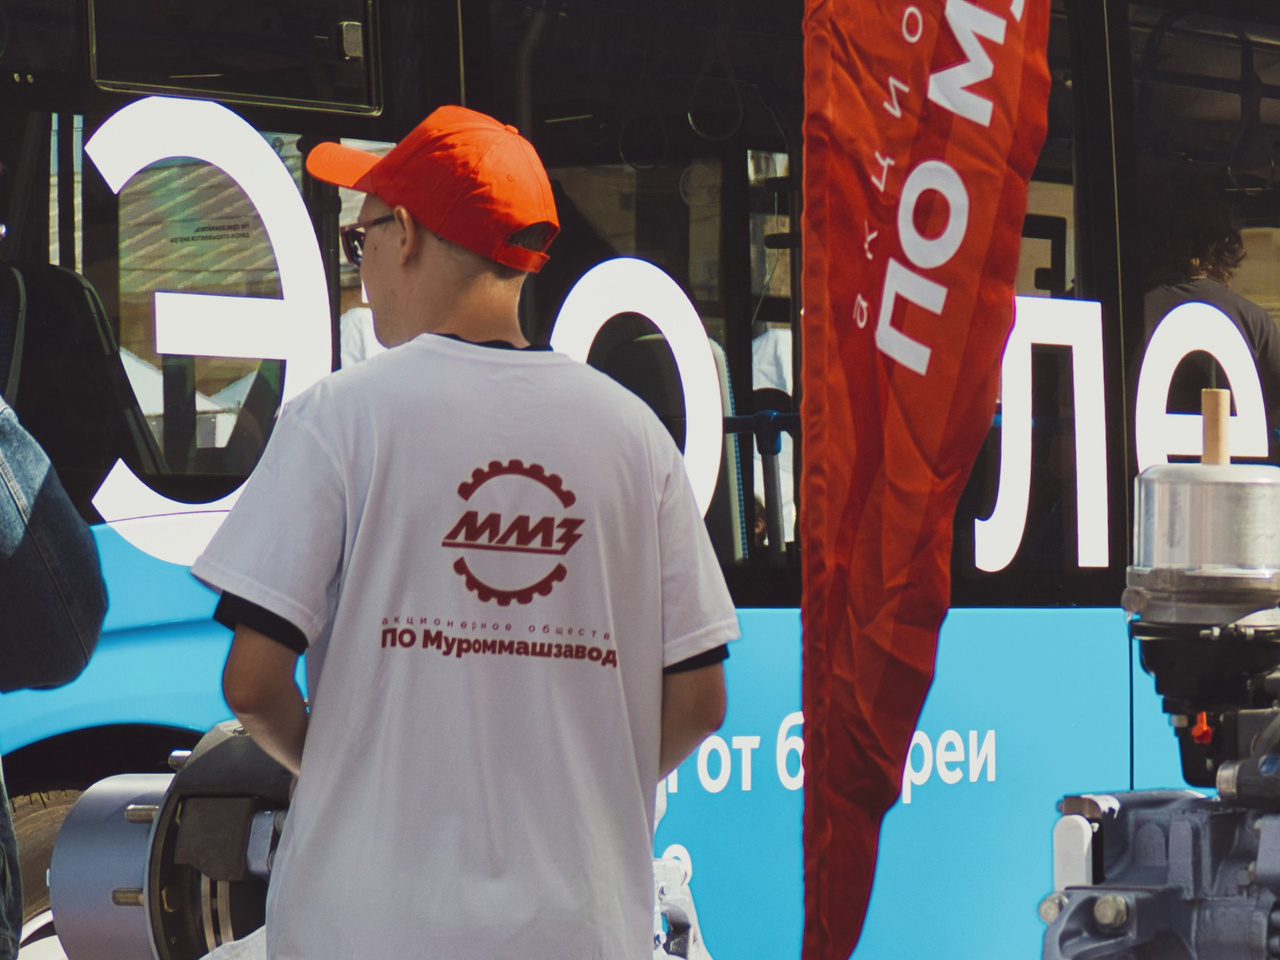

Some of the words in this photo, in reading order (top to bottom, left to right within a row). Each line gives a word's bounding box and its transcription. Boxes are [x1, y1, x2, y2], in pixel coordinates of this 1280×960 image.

[875, 159, 970, 376] ПО
[85, 96, 723, 566] Эо
[441, 510, 586, 556] ММЗ
[381, 628, 417, 649] ПО
[422, 629, 618, 668] Муроммашзавод
[382, 615, 512, 632] акционерное
[528, 623, 610, 641] обществ
[697, 734, 761, 793] от
[776, 711, 996, 804] бреи
